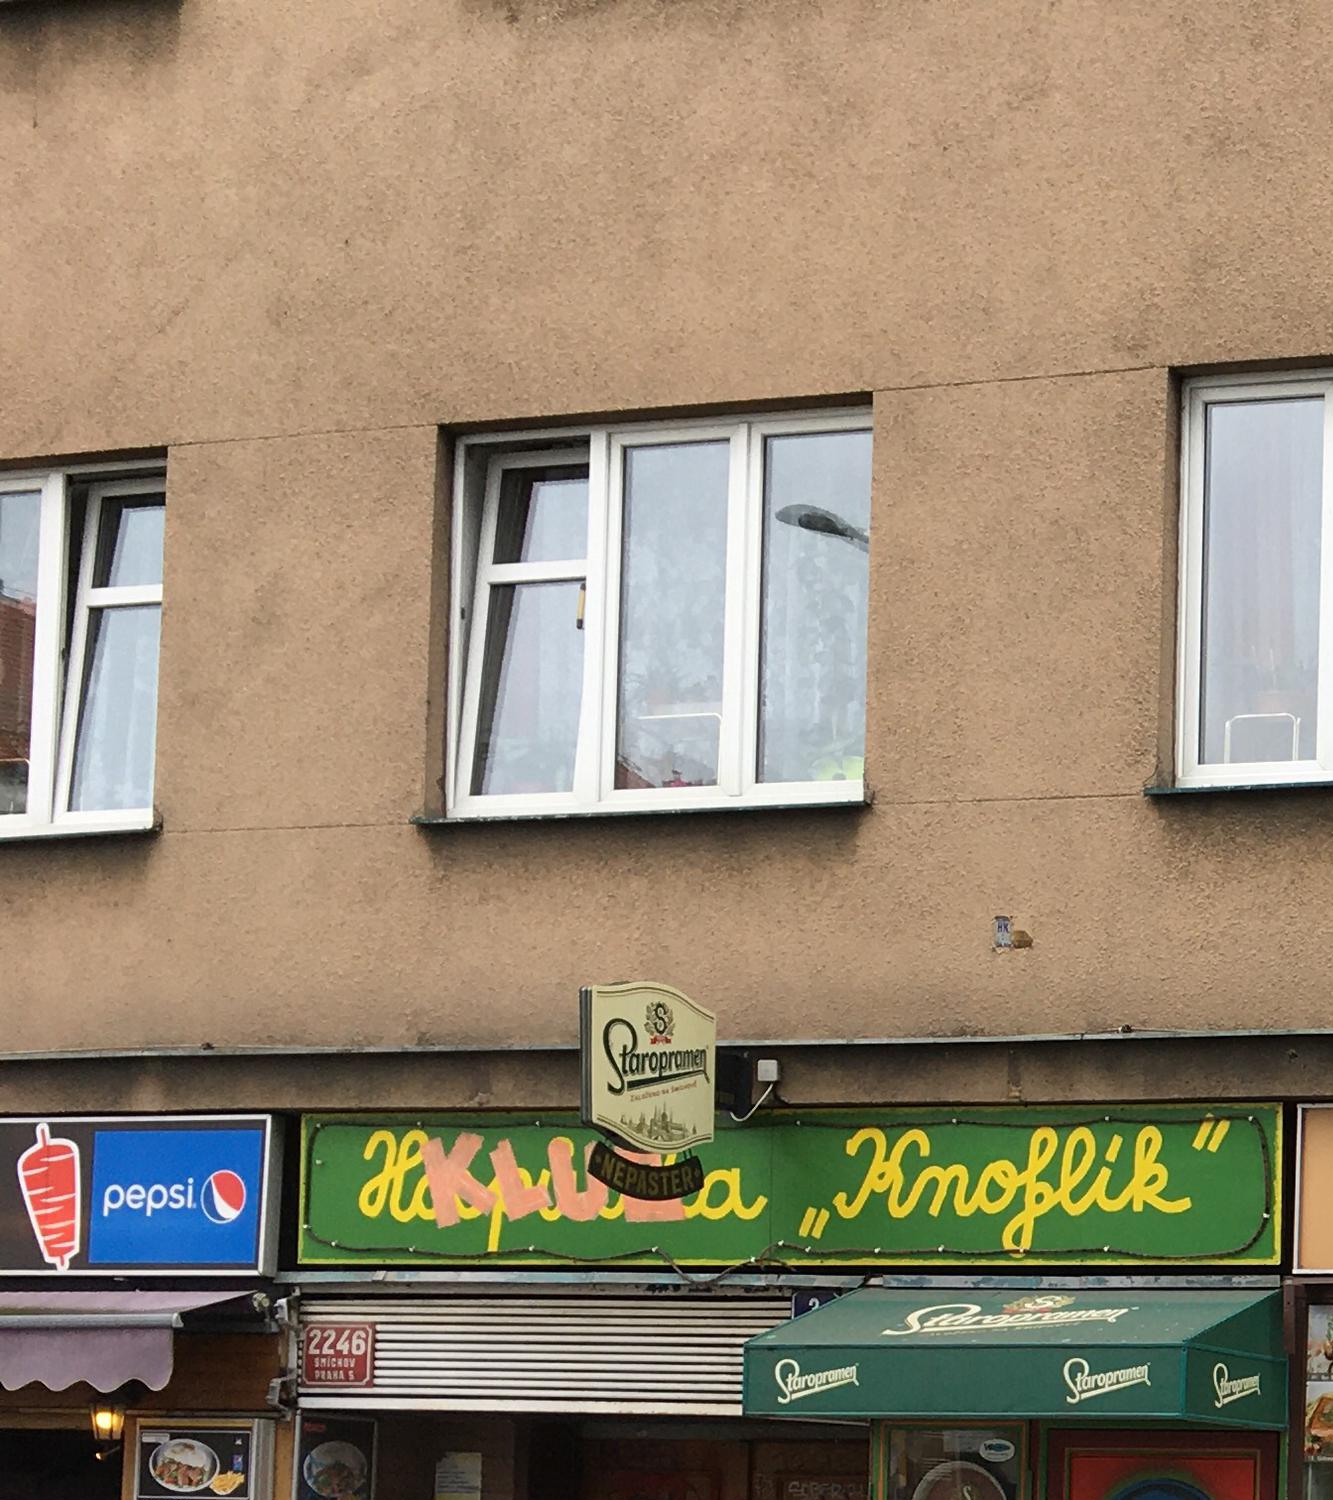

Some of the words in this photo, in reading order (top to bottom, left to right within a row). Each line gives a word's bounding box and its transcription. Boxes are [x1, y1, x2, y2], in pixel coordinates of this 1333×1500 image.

[603, 1018, 709, 1095] Staropramen
[601, 1153, 694, 1196] NEPASTER
[103, 1178, 197, 1217] pepsi
[881, 1303, 1129, 1336] Staropramen
[307, 1328, 367, 1356] 2246
[313, 1355, 356, 1368] SMÍCHOV
[314, 1370, 345, 1381] PRAHA
[775, 1358, 859, 1404] Staropramen
[1063, 1357, 1151, 1405] Staropramen
[1213, 1362, 1261, 1408] Staropramen
